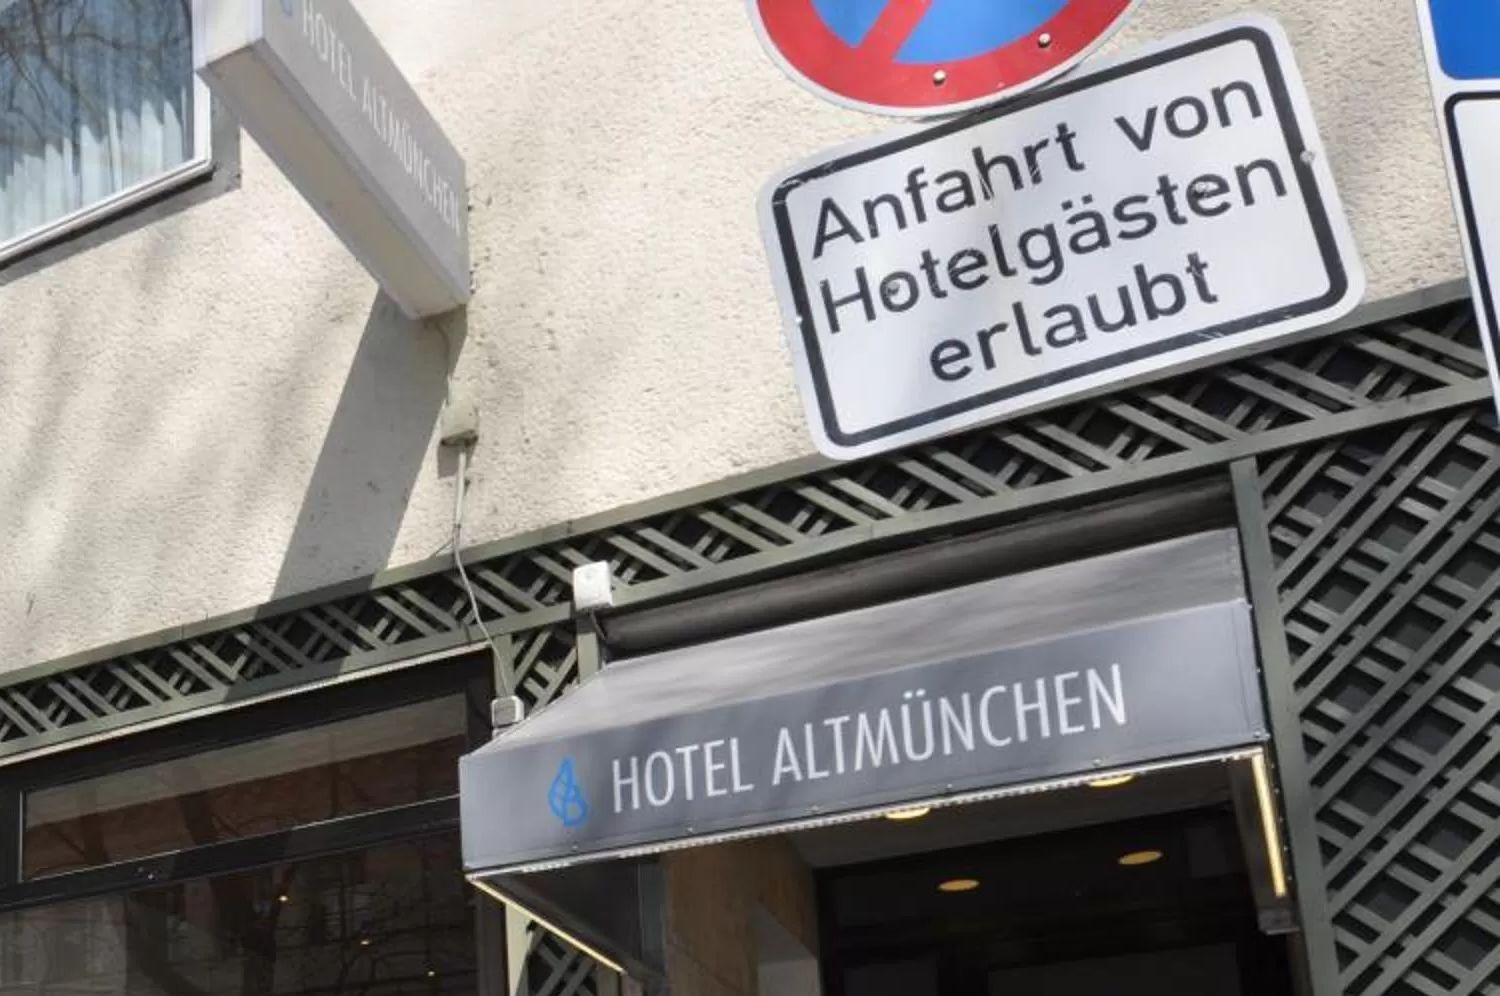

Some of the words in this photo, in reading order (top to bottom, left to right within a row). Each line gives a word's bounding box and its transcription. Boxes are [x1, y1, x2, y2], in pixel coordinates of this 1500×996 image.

[362, 76, 461, 238] ALTMÜNCHEN
[812, 122, 1085, 258] Anfahrt
[1115, 79, 1264, 152] von
[819, 155, 1288, 334] Hotelgästen
[929, 251, 1219, 382] erlaubt
[611, 737, 754, 814] HOTEL
[772, 663, 1127, 787] ALTMÜNCHEN
